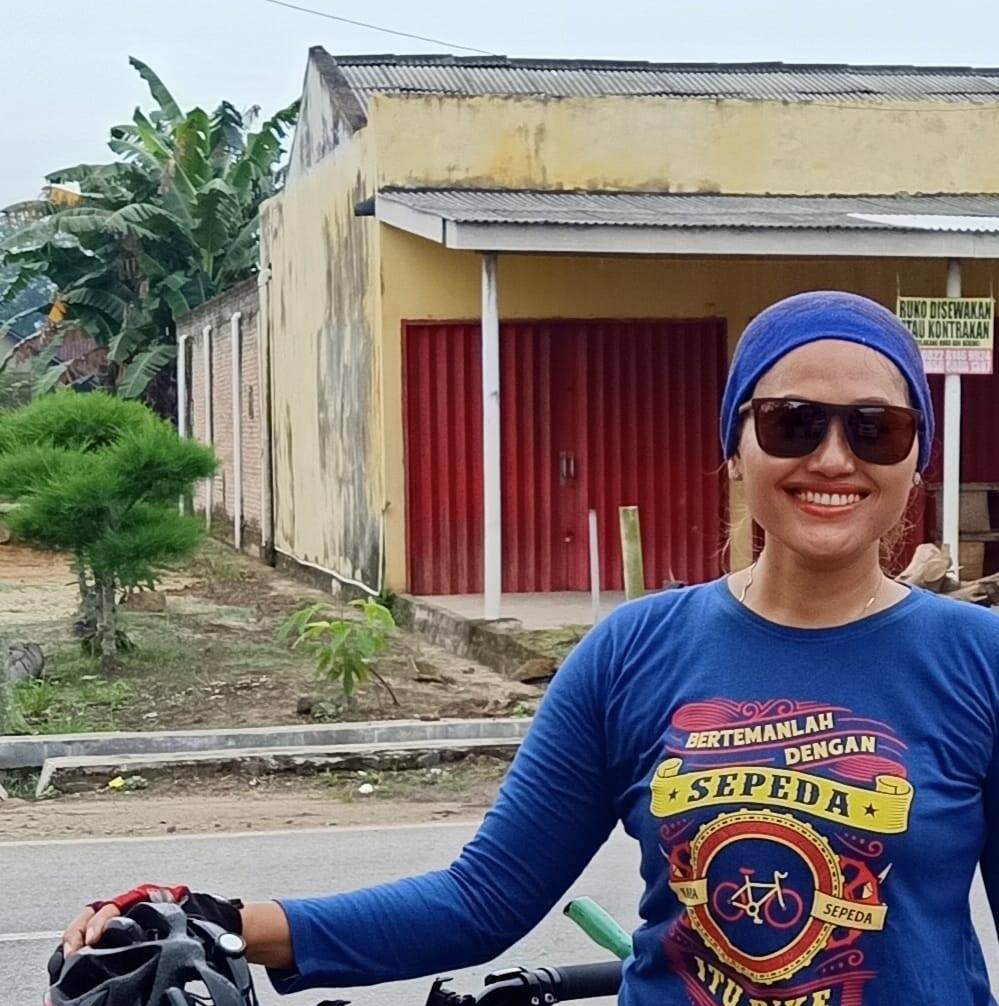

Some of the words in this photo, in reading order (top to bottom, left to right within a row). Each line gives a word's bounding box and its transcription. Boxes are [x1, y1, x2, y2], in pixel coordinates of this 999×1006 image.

[900, 301, 927, 318] RUKO
[930, 301, 991, 320] DISEWAKAN
[903, 320, 925, 338] TAU
[928, 321, 990, 339] KONTRAKAN
[685, 712, 833, 748] BERTEMANLAH
[784, 736, 876, 766] DENGAN
[687, 772, 850, 817] SEPEDA
[823, 903, 872, 924] SEPEDA
